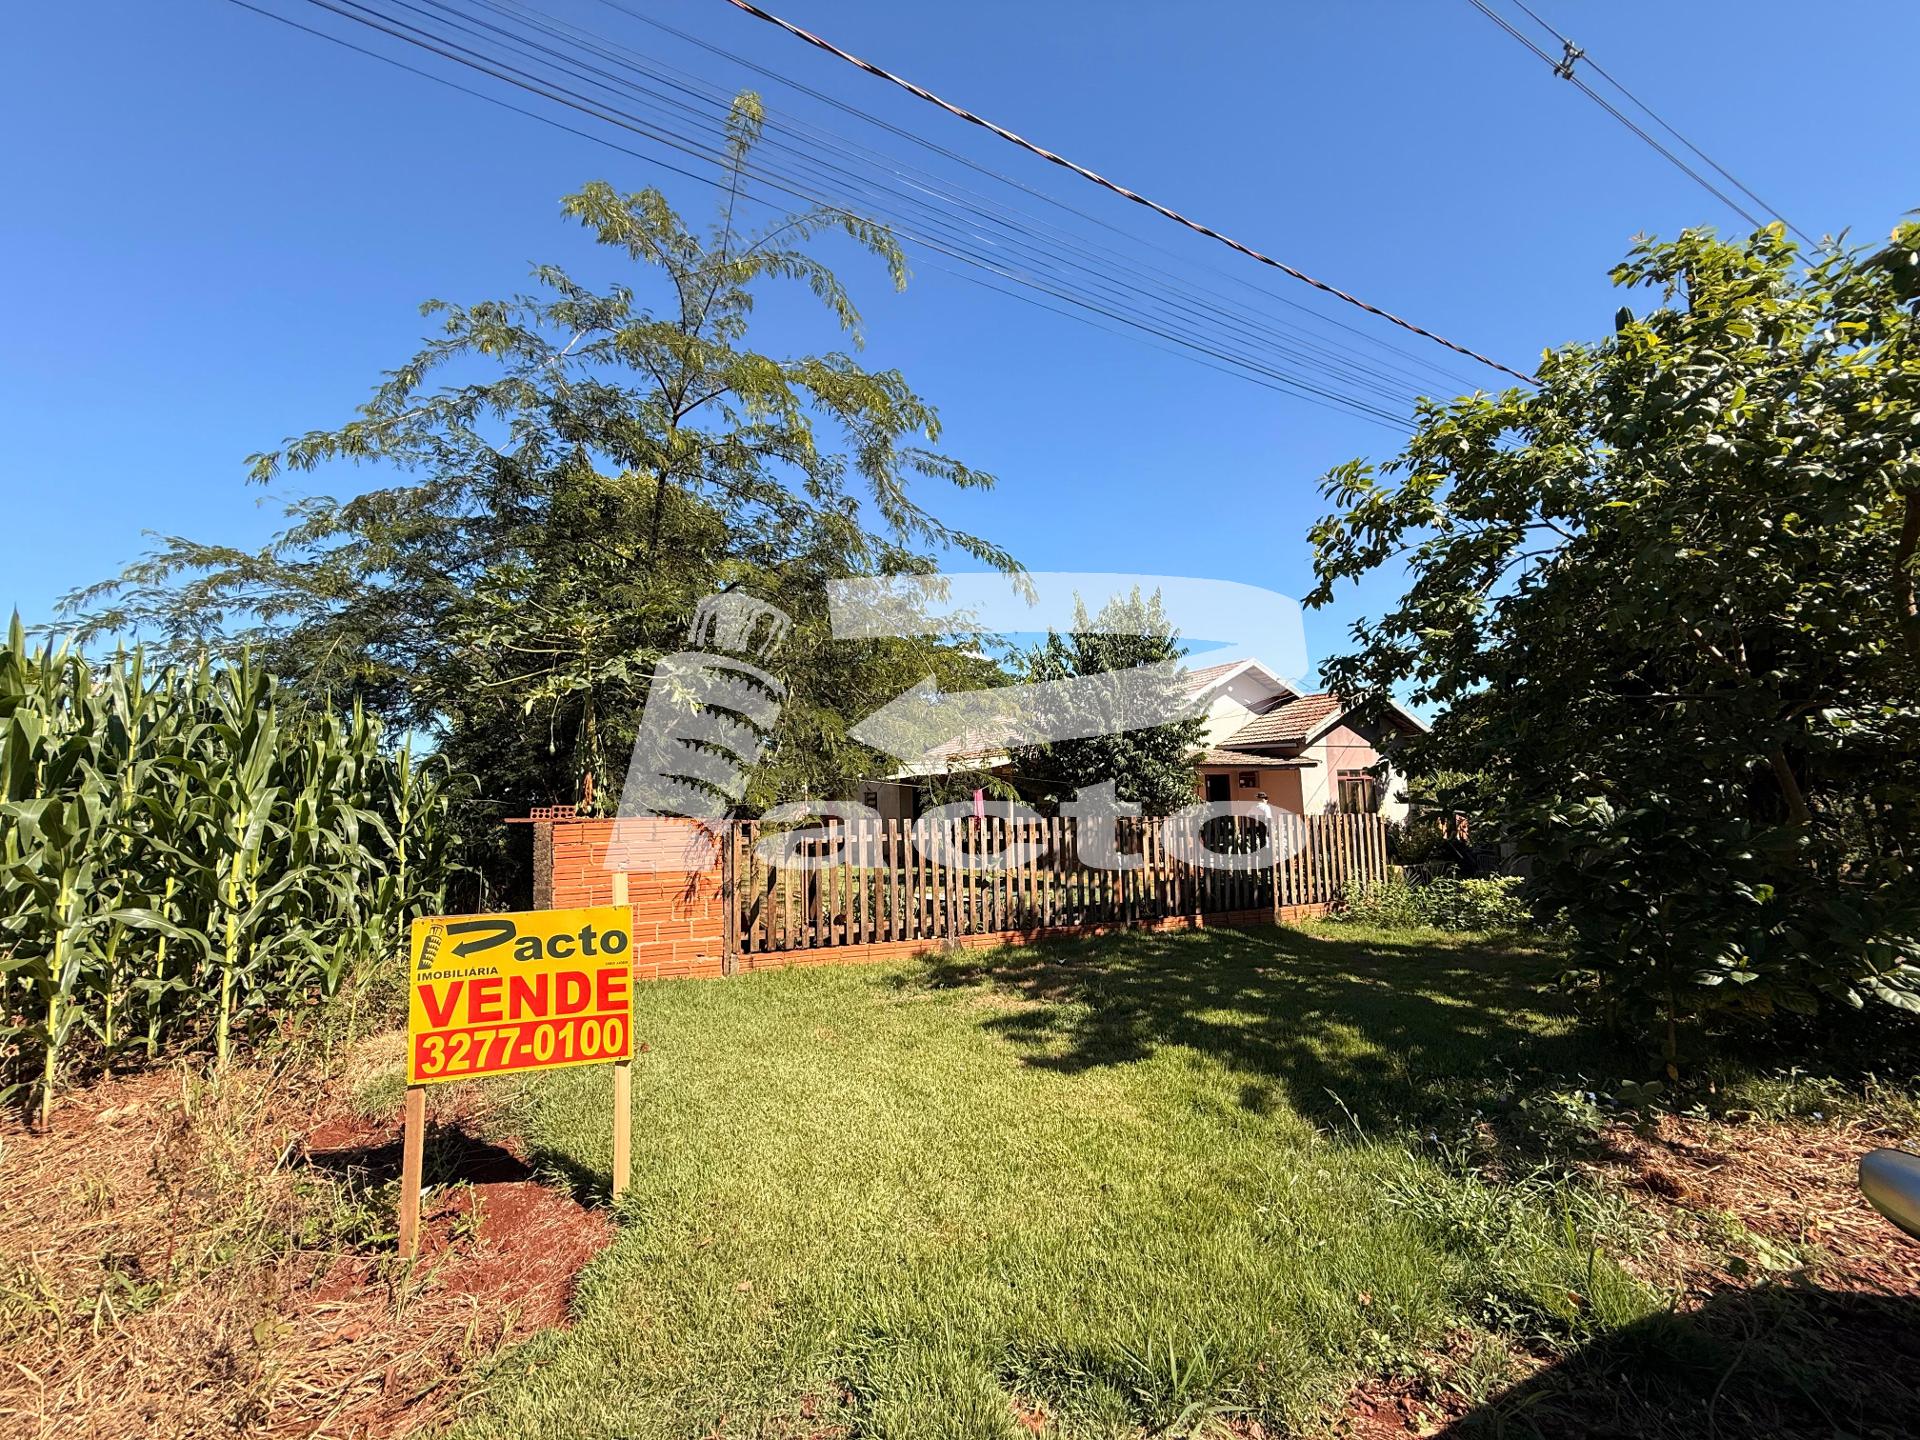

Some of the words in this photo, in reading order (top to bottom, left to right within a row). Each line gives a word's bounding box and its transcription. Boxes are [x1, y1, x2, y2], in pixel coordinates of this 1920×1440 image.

[417, 920, 628, 970] Pacto
[417, 966, 498, 981] IMOBILIÁRIA
[417, 967, 628, 1029] VENDE
[421, 1017, 623, 1075] 3277-0100
